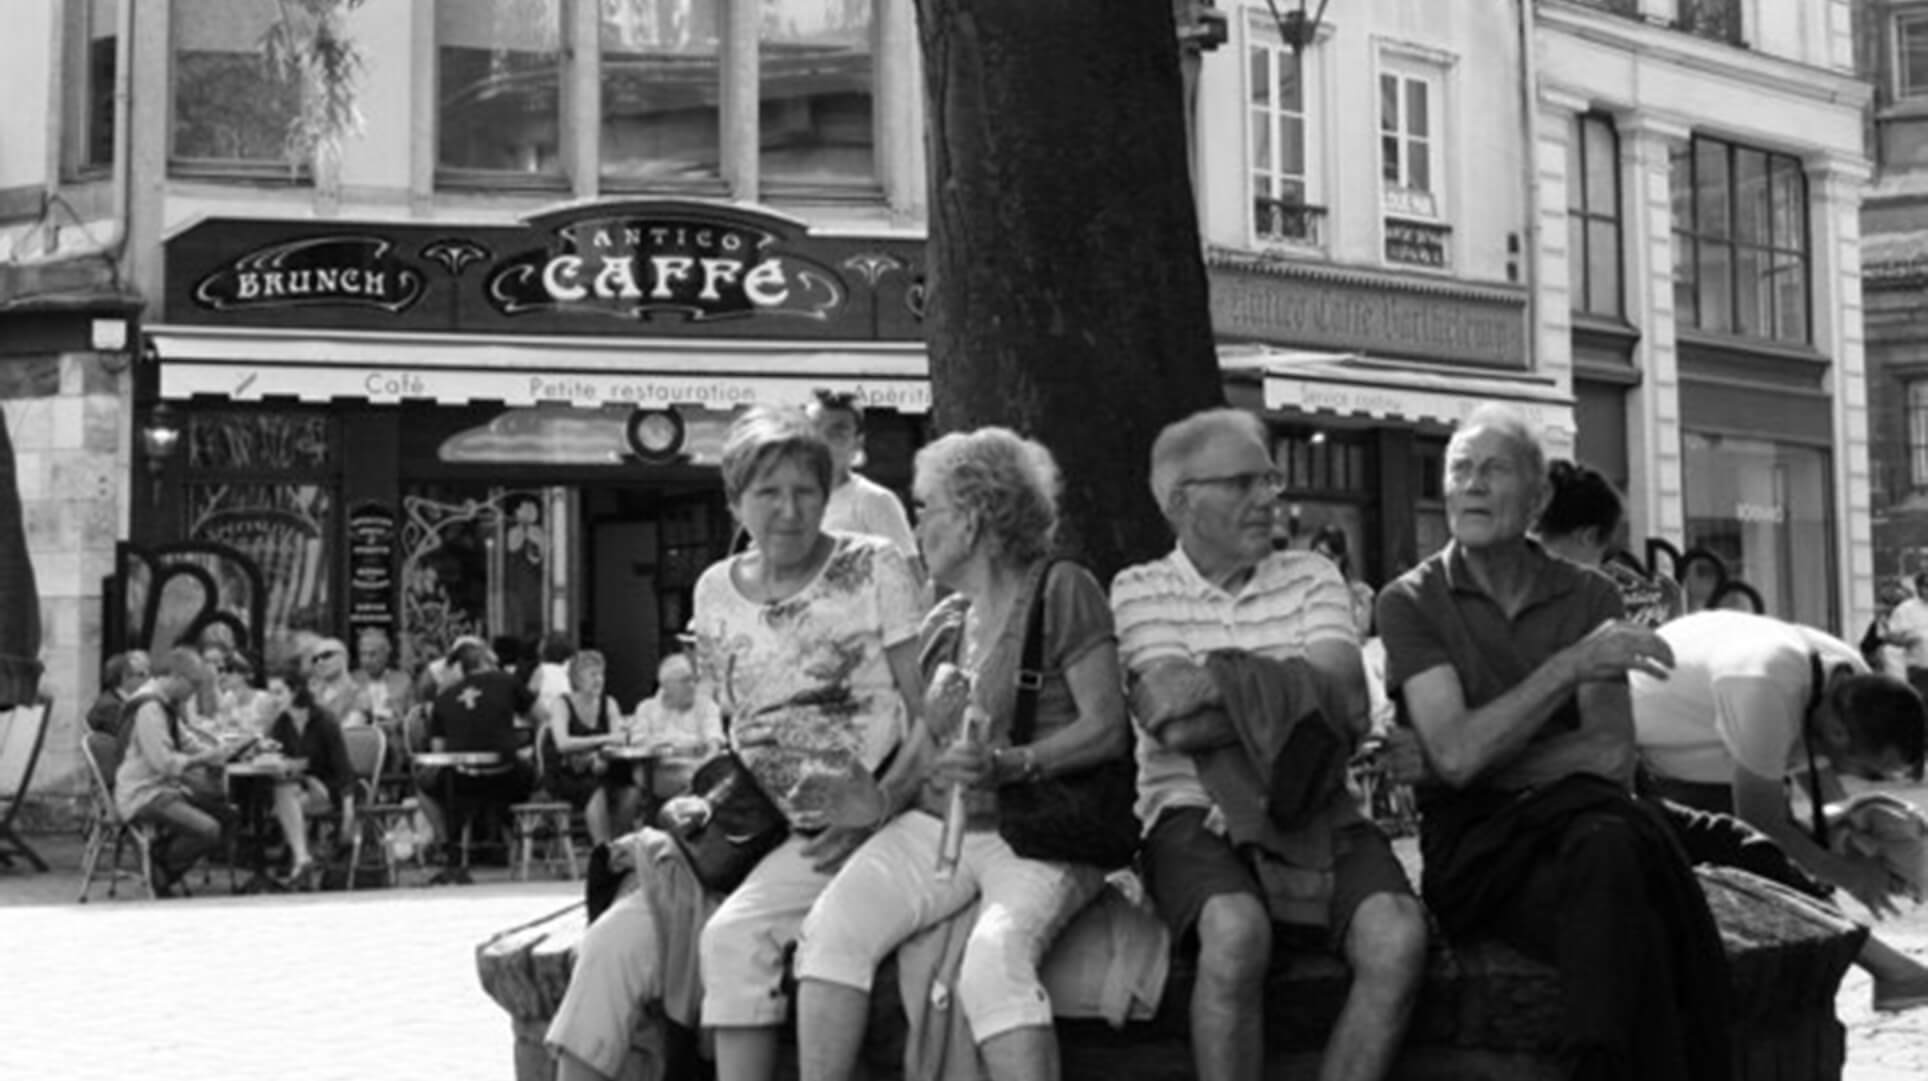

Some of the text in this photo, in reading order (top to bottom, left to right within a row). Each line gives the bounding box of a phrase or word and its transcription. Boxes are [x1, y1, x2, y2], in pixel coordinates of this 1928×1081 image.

[593, 228, 742, 250] ANTICO
[236, 268, 387, 300] BRUNCH
[364, 372, 425, 396] Café
[529, 376, 596, 401] Petite
[610, 379, 757, 401] restauration
